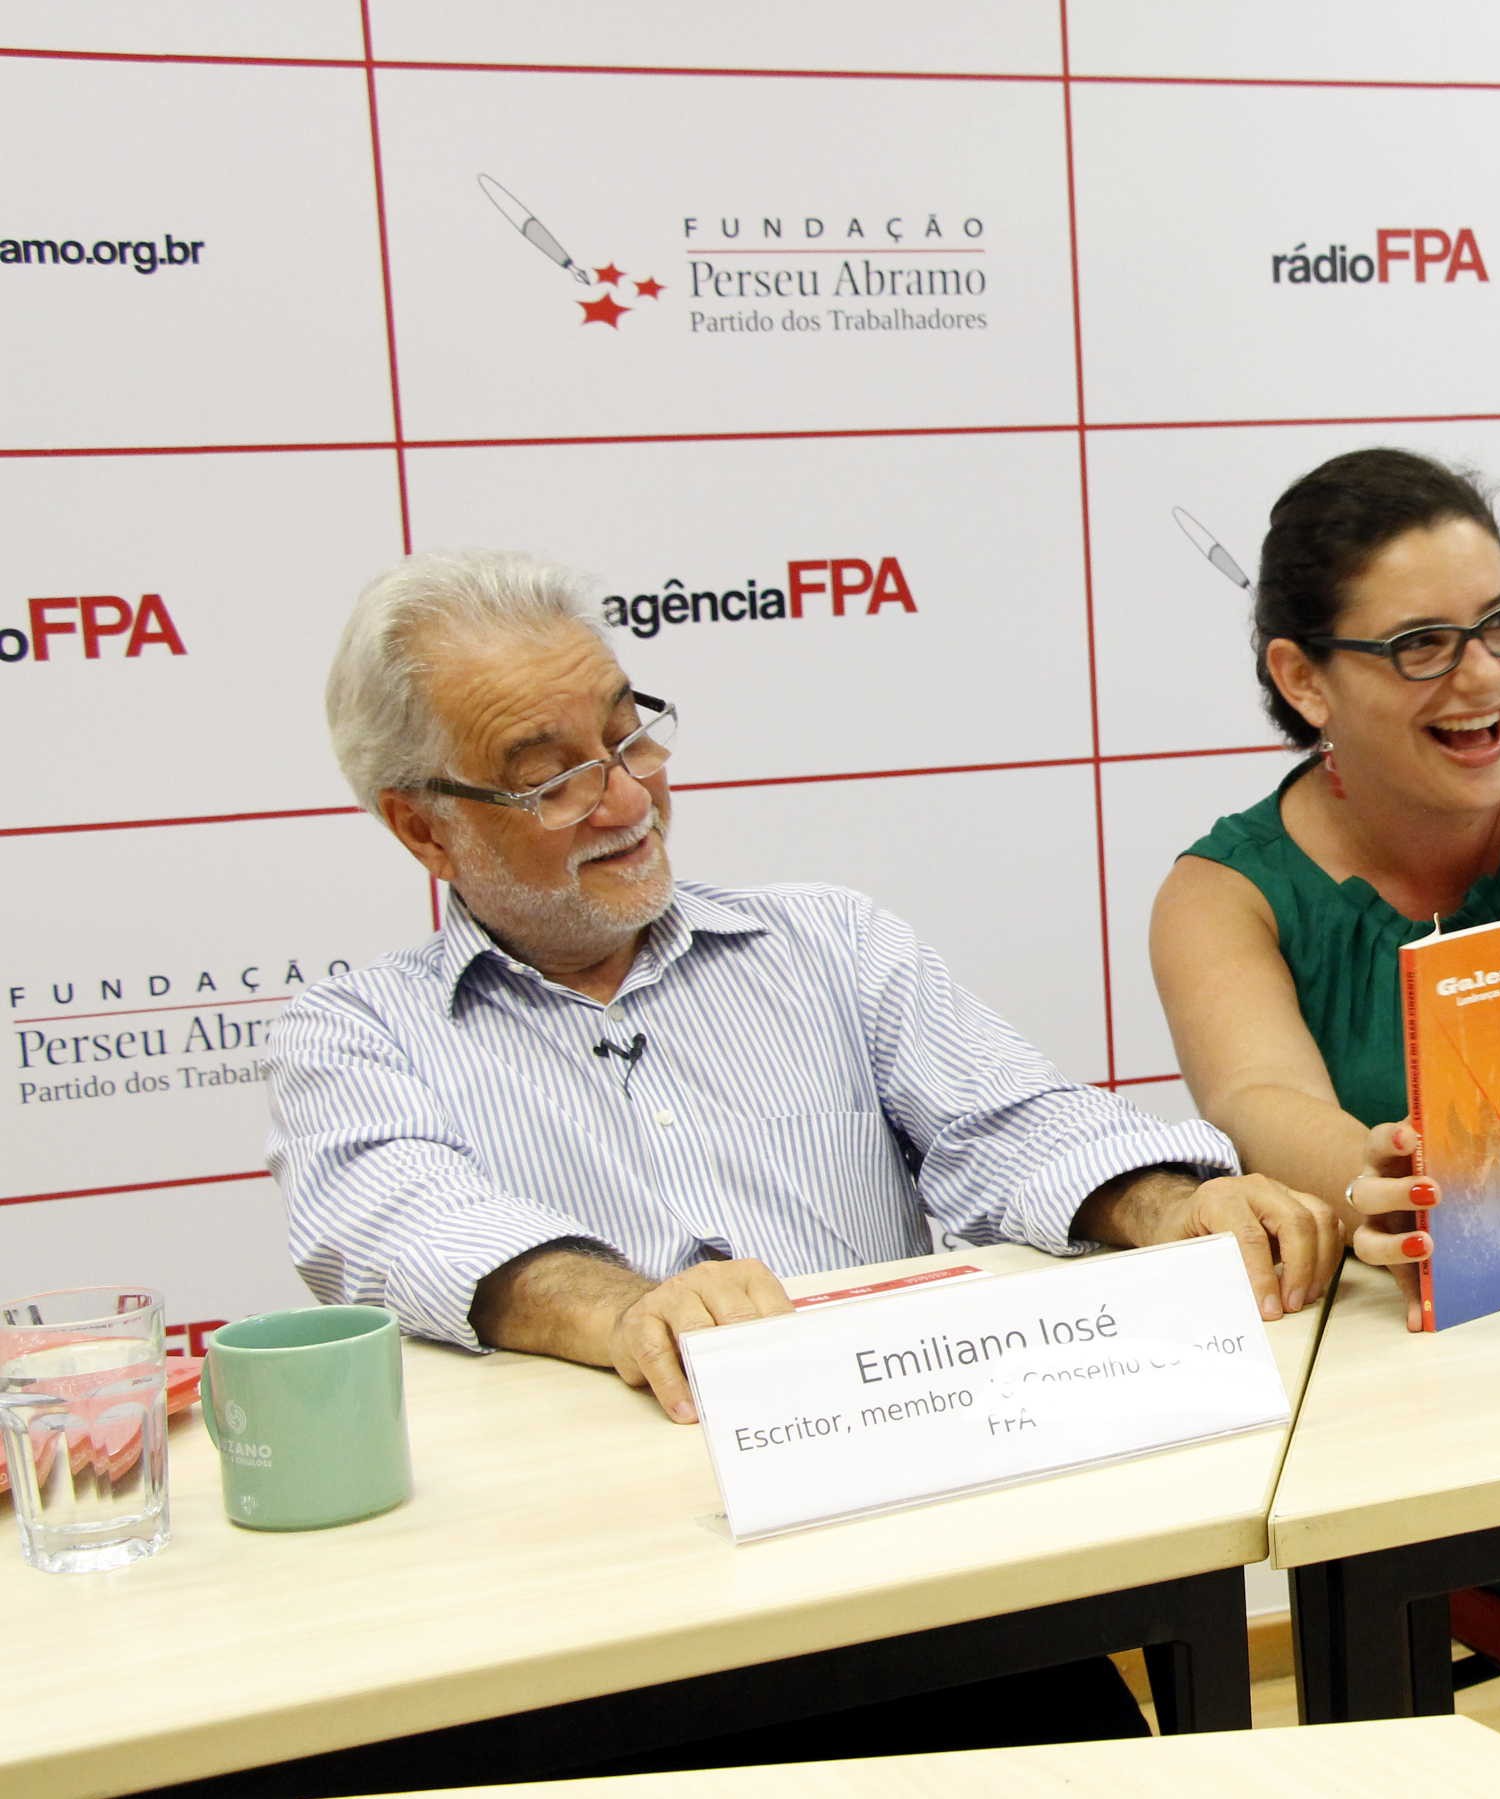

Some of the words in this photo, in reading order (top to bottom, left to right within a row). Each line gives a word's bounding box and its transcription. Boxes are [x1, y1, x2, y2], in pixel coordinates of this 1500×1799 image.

[689, 259, 820, 298] Perseu
[833, 258, 987, 297] Abramo
[690, 310, 774, 333] Partido
[782, 309, 821, 332] dos
[829, 308, 988, 331] Trabalhadores
[15, 1023, 168, 1070] Perseu
[19, 1075, 117, 1105] Partido
[125, 1070, 171, 1095] dos
[735, 1413, 852, 1452] Escritor,
[861, 1389, 974, 1427] membro
